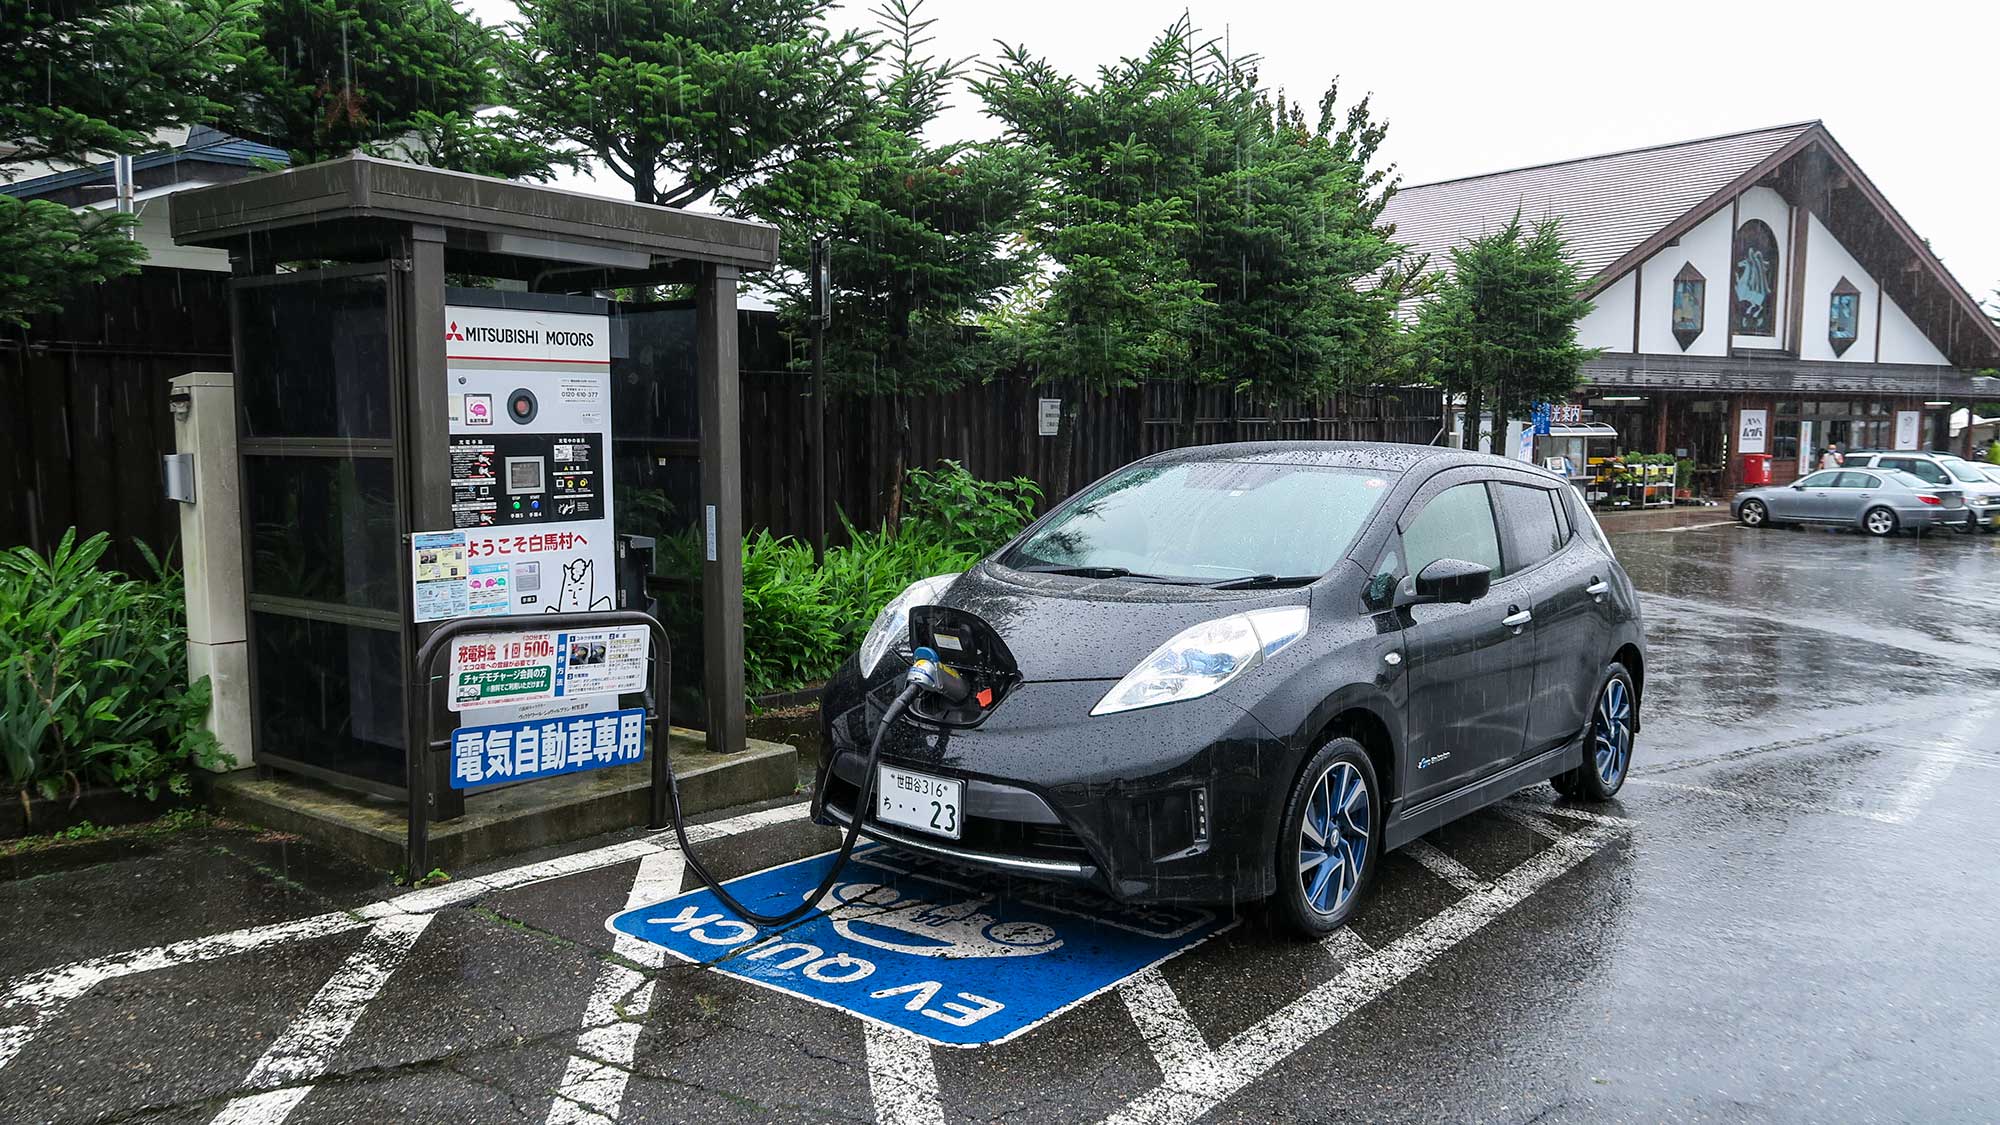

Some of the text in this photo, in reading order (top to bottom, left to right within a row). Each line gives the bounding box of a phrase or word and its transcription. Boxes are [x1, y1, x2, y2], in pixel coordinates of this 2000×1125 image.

[466, 327, 594, 347] MITSUBISHI MOTORS
[468, 532, 588, 557] ようこそ白馬村へ
[458, 644, 497, 663] 充電料金
[464, 668, 547, 684] チャデモチャージ会員の方
[456, 713, 643, 782] 電気自動車専用
[646, 905, 1005, 1027] EV QUICK
